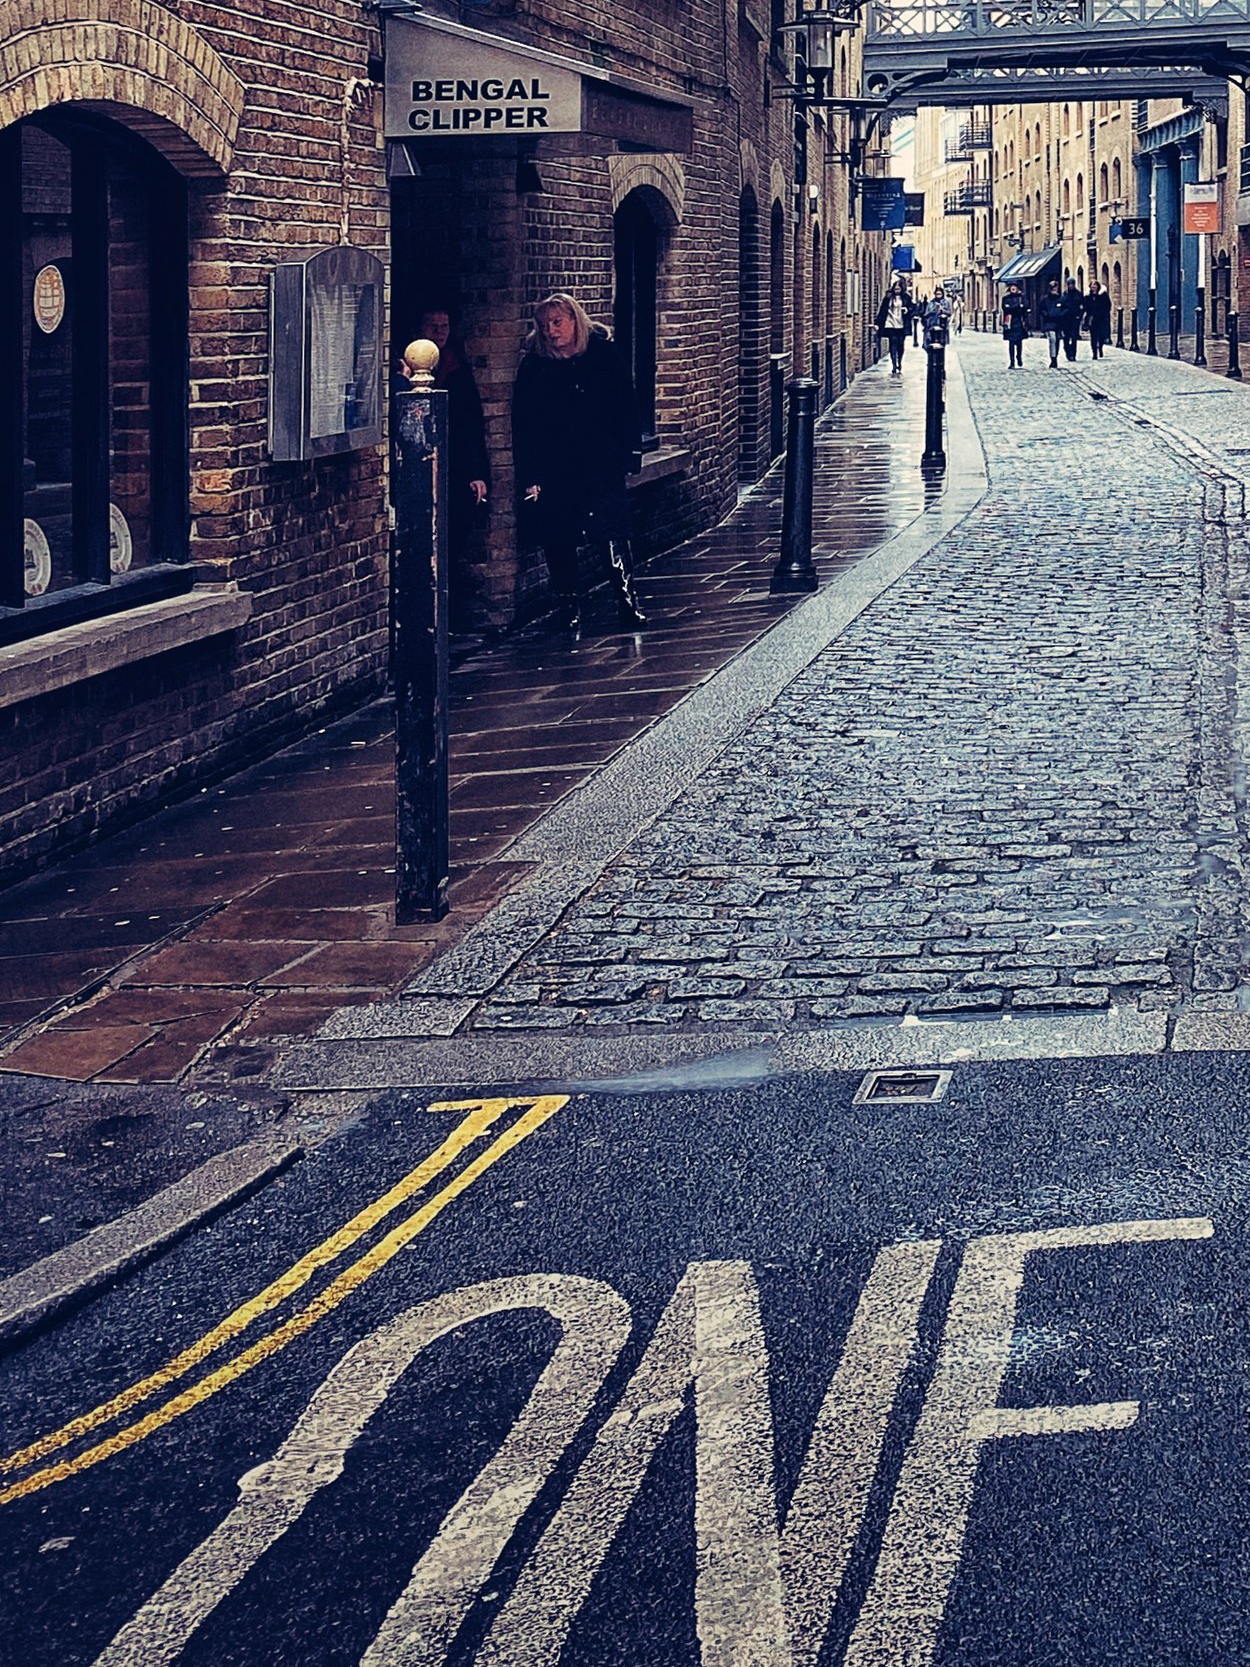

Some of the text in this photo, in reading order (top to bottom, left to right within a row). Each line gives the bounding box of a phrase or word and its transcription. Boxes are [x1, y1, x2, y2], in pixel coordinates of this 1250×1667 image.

[411, 78, 549, 102] BENGAL
[408, 107, 549, 131] CLIPPER
[1128, 222, 1144, 235] 36
[90, 1217, 1215, 1667] ONE
